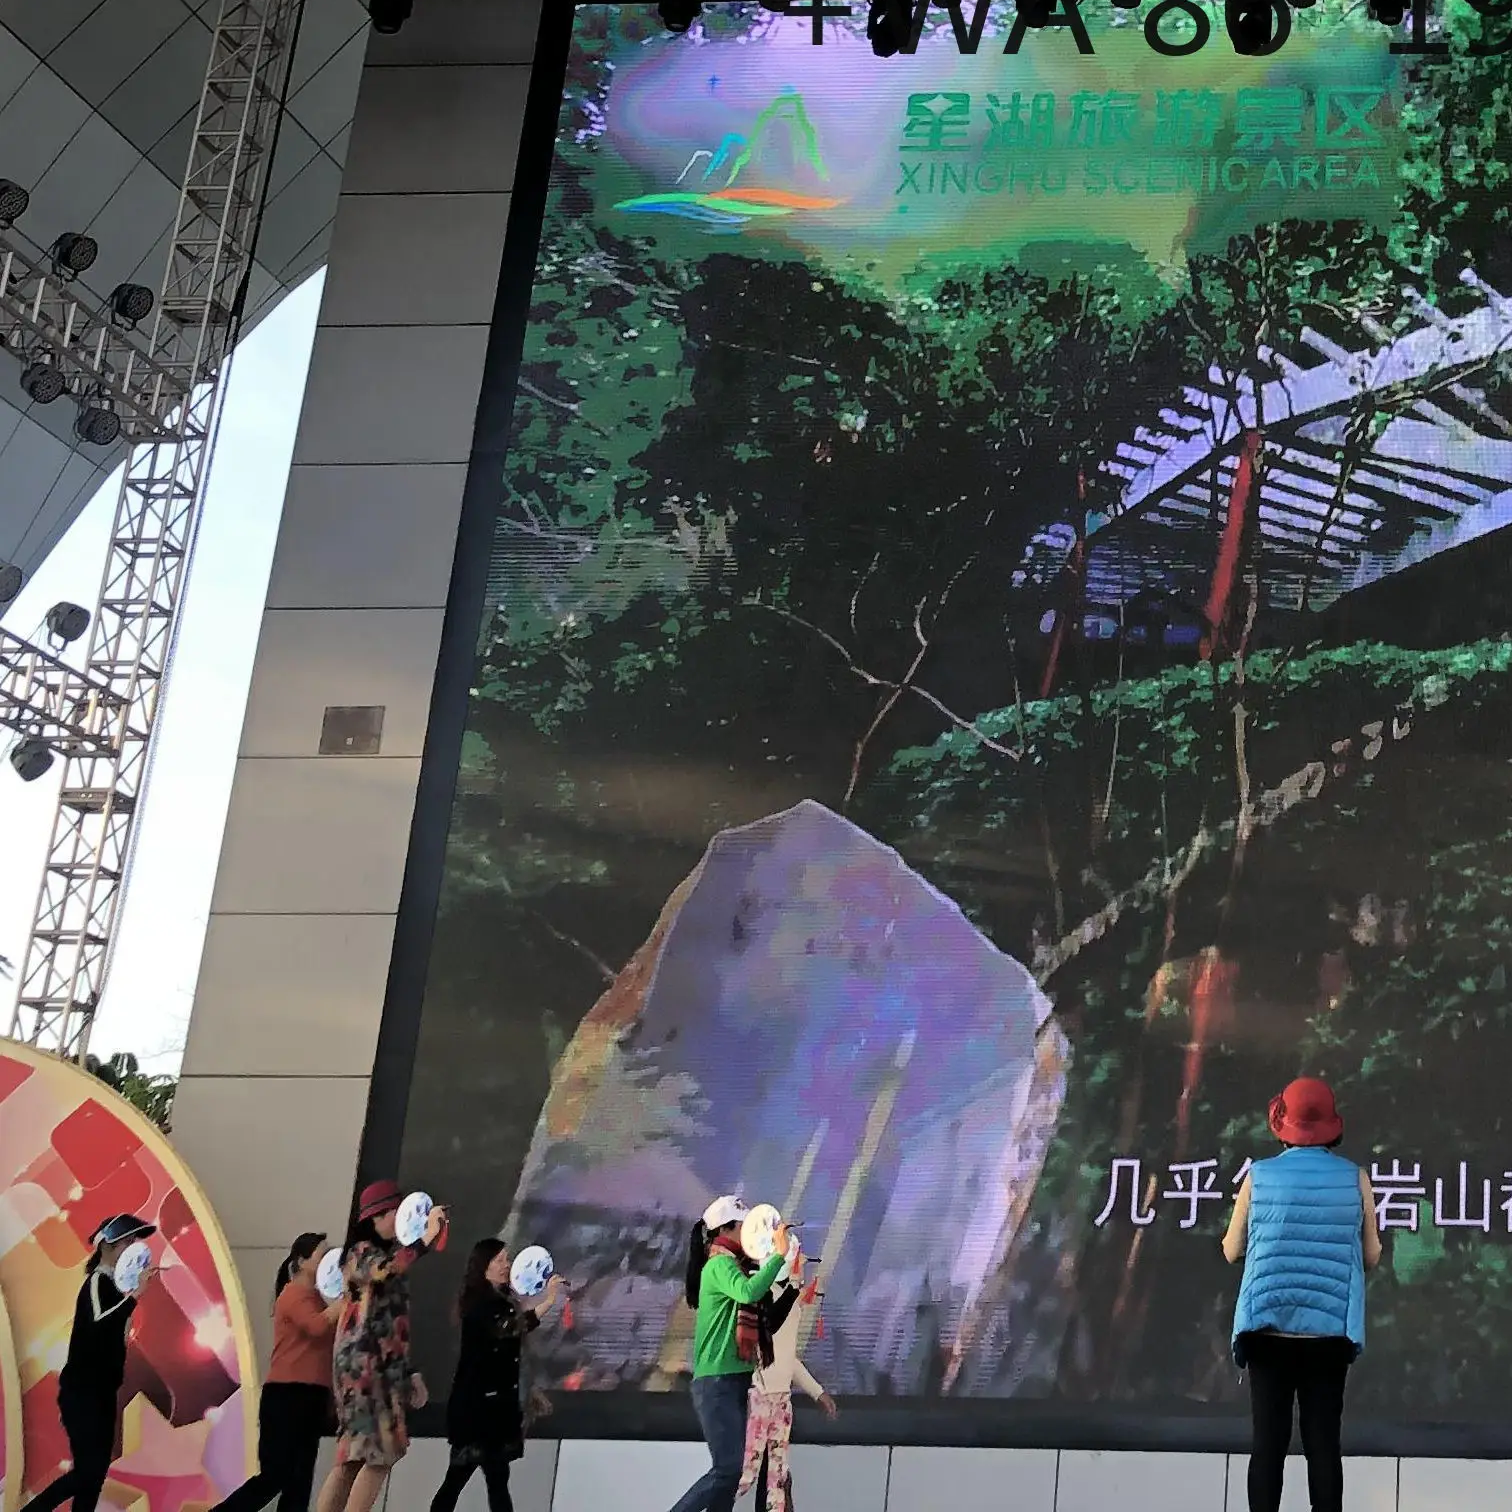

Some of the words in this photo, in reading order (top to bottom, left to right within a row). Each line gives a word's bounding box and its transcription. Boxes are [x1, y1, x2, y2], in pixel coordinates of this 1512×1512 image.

[898, 90, 1387, 152] 星湖旅游景区
[894, 160, 1067, 196] XINGHU
[1084, 156, 1250, 195] SCENIC
[1258, 153, 1383, 192] AREA
